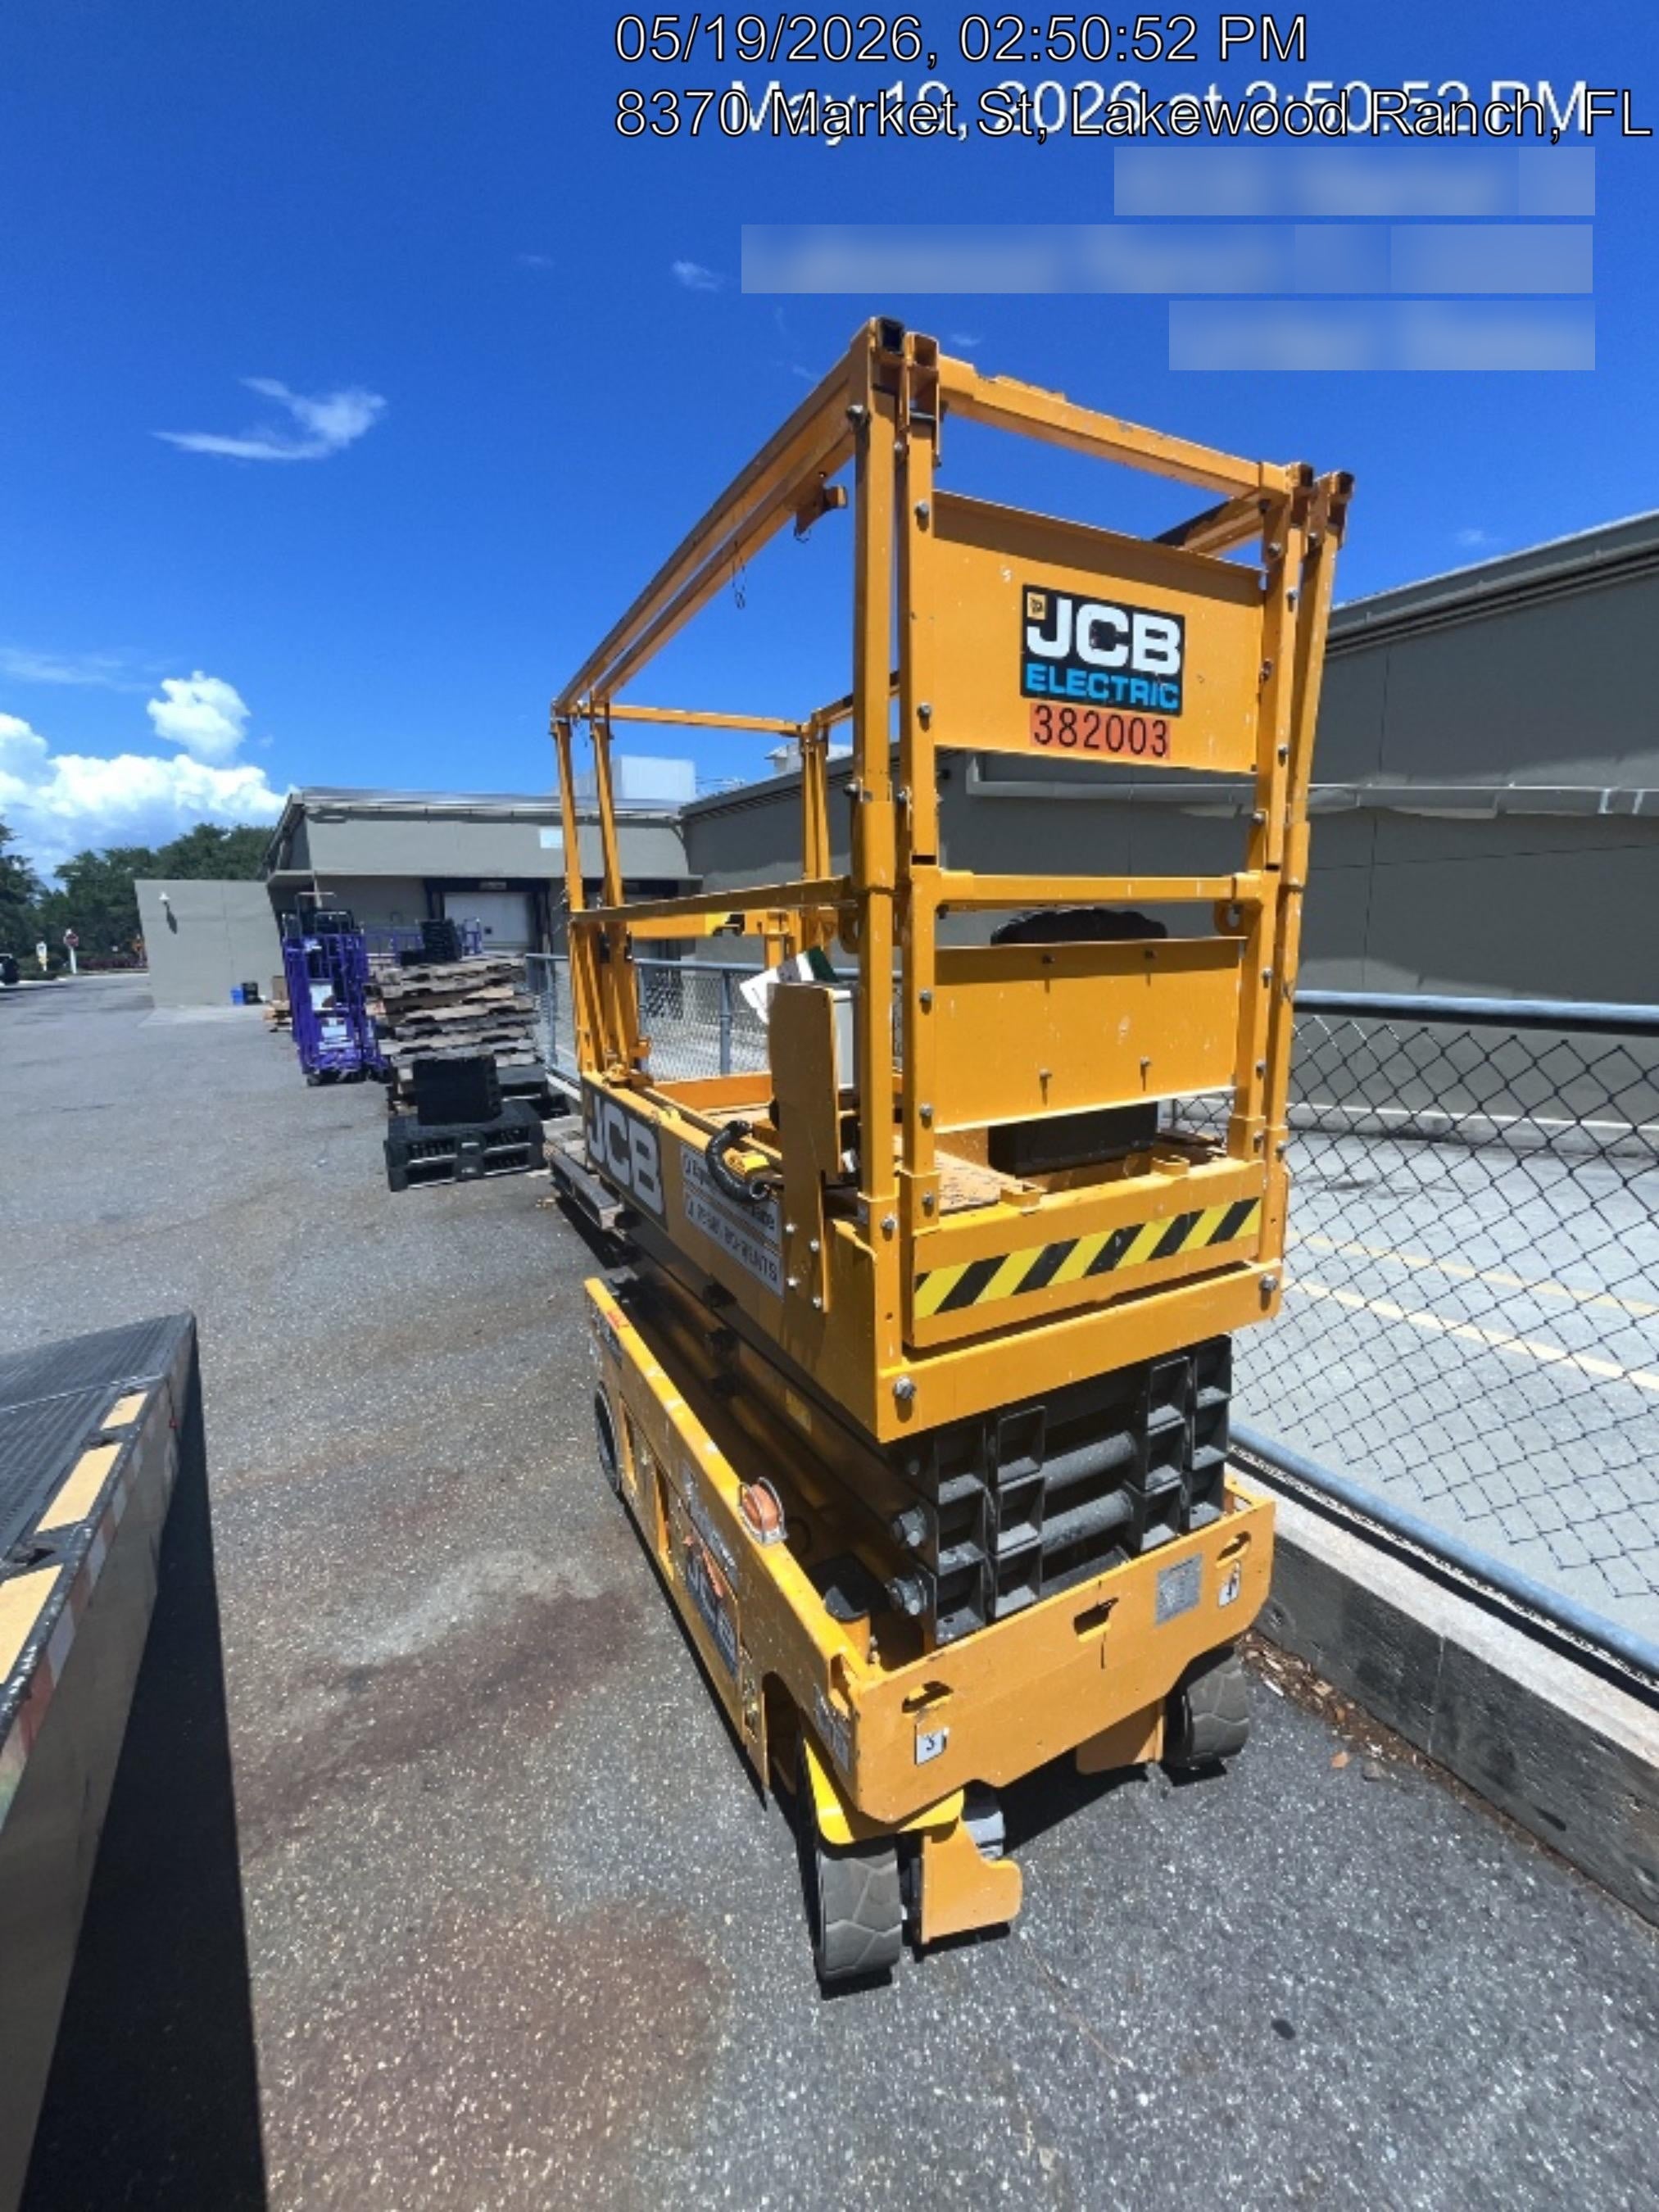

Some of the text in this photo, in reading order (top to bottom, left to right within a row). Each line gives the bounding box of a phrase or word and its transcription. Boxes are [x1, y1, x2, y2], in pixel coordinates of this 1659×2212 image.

[1027, 596, 1181, 676] JCB
[1026, 663, 1180, 709] ELECTRIC
[1033, 705, 1167, 757] 382003
[587, 1094, 663, 1216] JCB
